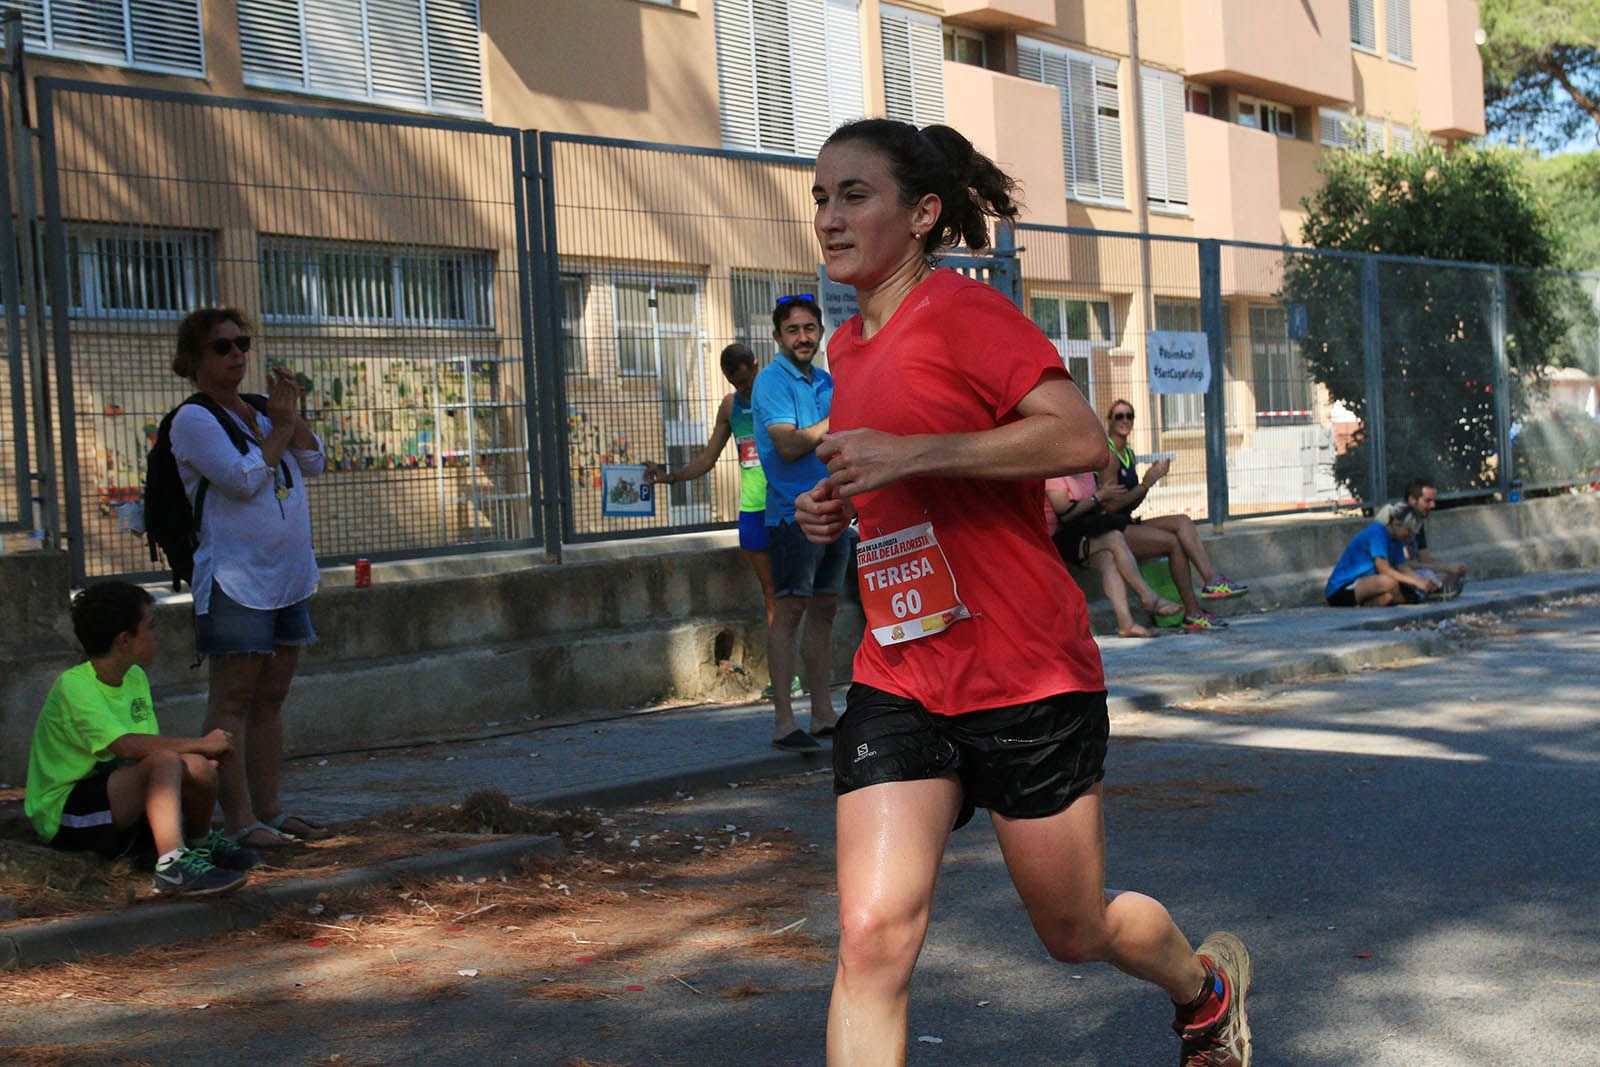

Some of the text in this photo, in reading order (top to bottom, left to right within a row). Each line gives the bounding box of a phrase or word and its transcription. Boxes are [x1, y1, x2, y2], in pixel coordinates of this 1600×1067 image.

[857, 536, 930, 565] TRAIL DE LA FLORESTA
[864, 556, 935, 592] TERESA
[891, 588, 922, 619] 60
